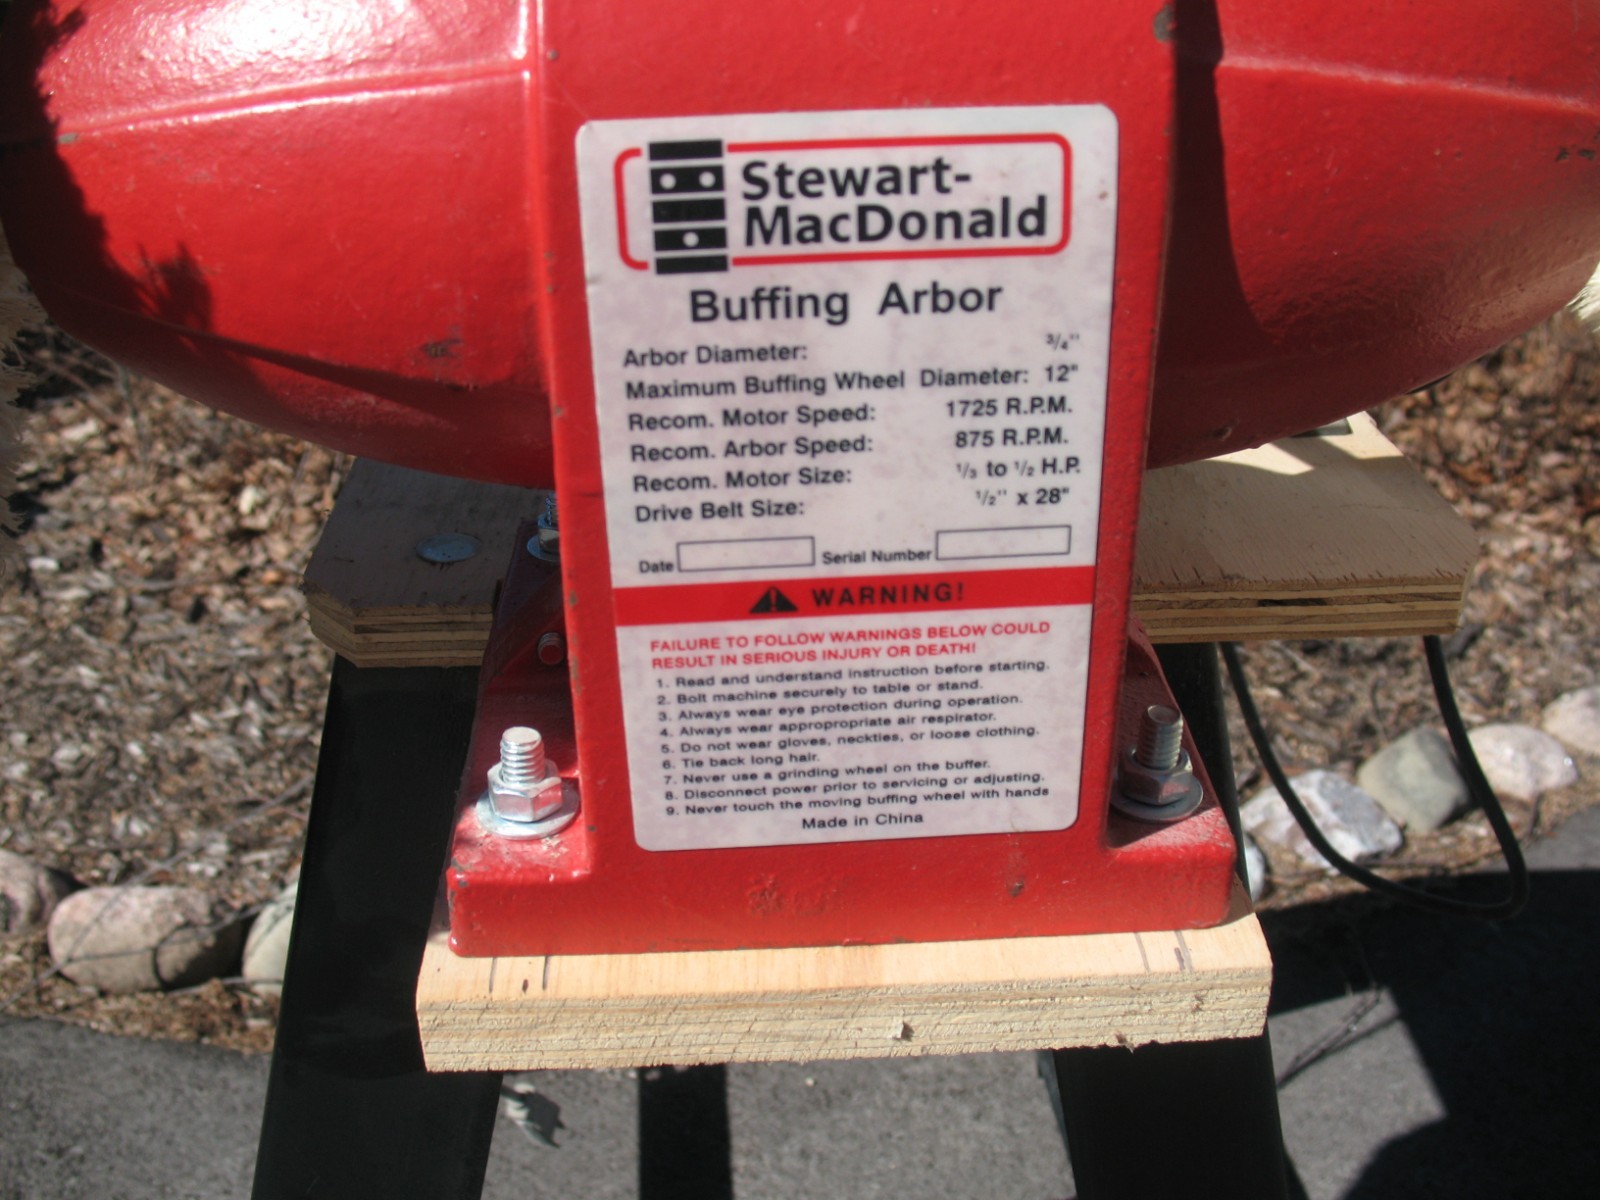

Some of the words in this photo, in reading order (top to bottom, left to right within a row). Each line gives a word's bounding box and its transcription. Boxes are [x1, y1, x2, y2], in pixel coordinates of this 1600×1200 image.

[742, 157, 972, 200] Stewart-
[745, 196, 1047, 248] MacDonald
[689, 286, 849, 326] Buffing
[878, 280, 1004, 316] Arbor
[623, 348, 688, 368] Arbor
[696, 343, 807, 365] Diameter:
[625, 379, 736, 400] Maximum
[744, 374, 827, 396] Buffing
[833, 370, 905, 390] Wheel
[919, 367, 1028, 388] Diameter:
[627, 412, 714, 432] Recom.
[722, 408, 789, 427] Motor
[795, 403, 875, 429] Speed:
[946, 398, 998, 417] 1725
[1006, 395, 1072, 415] R.P.M.
[630, 443, 716, 463] Recom.
[723, 439, 788, 458] Arbor
[793, 434, 872, 459] Speed:
[954, 430, 995, 449] 875
[1002, 426, 1068, 446] R.P.M.
[632, 474, 718, 493] Recom.
[725, 470, 791, 489] Motor
[797, 466, 851, 486] Size:
[986, 460, 1008, 477] to
[1041, 456, 1080, 475] H.P.
[635, 504, 693, 523] Drive
[700, 501, 744, 520] Belt
[750, 499, 804, 518] Size:
[1017, 492, 1028, 506] x
[639, 560, 675, 574] Date
[822, 551, 866, 565] Serial
[870, 549, 933, 563] Number
[811, 581, 964, 608] WARNING!
[650, 636, 721, 652] FAILURE
[724, 635, 749, 649] TO
[753, 631, 825, 647] FOLLOW
[829, 627, 922, 643] WARNINGS
[927, 624, 987, 639] BELOW
[990, 621, 1051, 636] COULD
[651, 654, 716, 669] RESULT
[720, 654, 738, 666] IN
[742, 650, 818, 665] SERIOUS
[821, 646, 882, 661] INJURY
[886, 645, 911, 658] OR
[915, 642, 976, 657] DEATH!
[656, 678, 670, 688] 1.
[675, 676, 715, 687] Read
[720, 674, 750, 686] and
[755, 669, 843, 683] understand
[848, 666, 929, 679] instruction
[934, 663, 983, 675] before
[988, 660, 1049, 672] starting.
[656, 694, 671, 706] 2.
[676, 693, 707, 704] Bolt
[712, 690, 778, 702] machine
[783, 686, 847, 699] securely
[852, 685, 868, 695] to
[872, 683, 911, 694] table
[915, 683, 932, 692] or
[936, 679, 982, 692] stand.
[658, 710, 672, 722] 3.
[678, 710, 731, 721] Always
[736, 708, 773, 717] wear
[778, 706, 805, 717] eye
[810, 701, 887, 716] protection
[893, 698, 942, 710] during
[947, 694, 1022, 709] operation.
[659, 728, 673, 737] 4.
[679, 726, 732, 737] Always
[737, 724, 773, 733] wear
[897, 715, 916, 726] air
[921, 712, 996, 725] respirator.
[660, 743, 675, 754] 5.
[680, 742, 702, 753] Do
[707, 741, 731, 751] not
[736, 740, 772, 750] wear
[778, 737, 831, 750] gloves,
[837, 733, 904, 744] neckties,
[909, 731, 925, 741] or
[930, 730, 971, 739] loose
[975, 726, 1039, 738] clothing.
[662, 759, 675, 770] 6.
[681, 758, 704, 768] Tie
[709, 756, 745, 767] back
[750, 755, 784, 766] long
[788, 752, 820, 763] hair.
[664, 774, 677, 785] 7.
[682, 774, 726, 784] Never
[732, 772, 758, 781] use
[763, 772, 773, 780] a
[778, 767, 839, 781] grinding
[845, 764, 887, 775] wheel
[893, 764, 911, 773] on
[916, 762, 940, 771] the
[945, 759, 990, 770] buffer.
[665, 790, 678, 800] 8.
[684, 786, 767, 799] Disconnect
[772, 785, 818, 797] power
[822, 782, 857, 794] prior
[862, 781, 877, 790] to
[882, 777, 948, 789] servicing
[953, 776, 968, 785] or
[973, 773, 1044, 785] adjusting.
[665, 806, 679, 816] 9.
[685, 805, 728, 814] Never
[732, 801, 775, 812] touch
[779, 800, 803, 810] the
[808, 797, 862, 808] moving
[866, 794, 918, 805] buffing
[923, 790, 965, 801] wheel
[970, 789, 1000, 799] with
[1005, 787, 1049, 798] hands
[802, 816, 848, 829] Made
[854, 815, 869, 826] in
[875, 813, 924, 825] China
